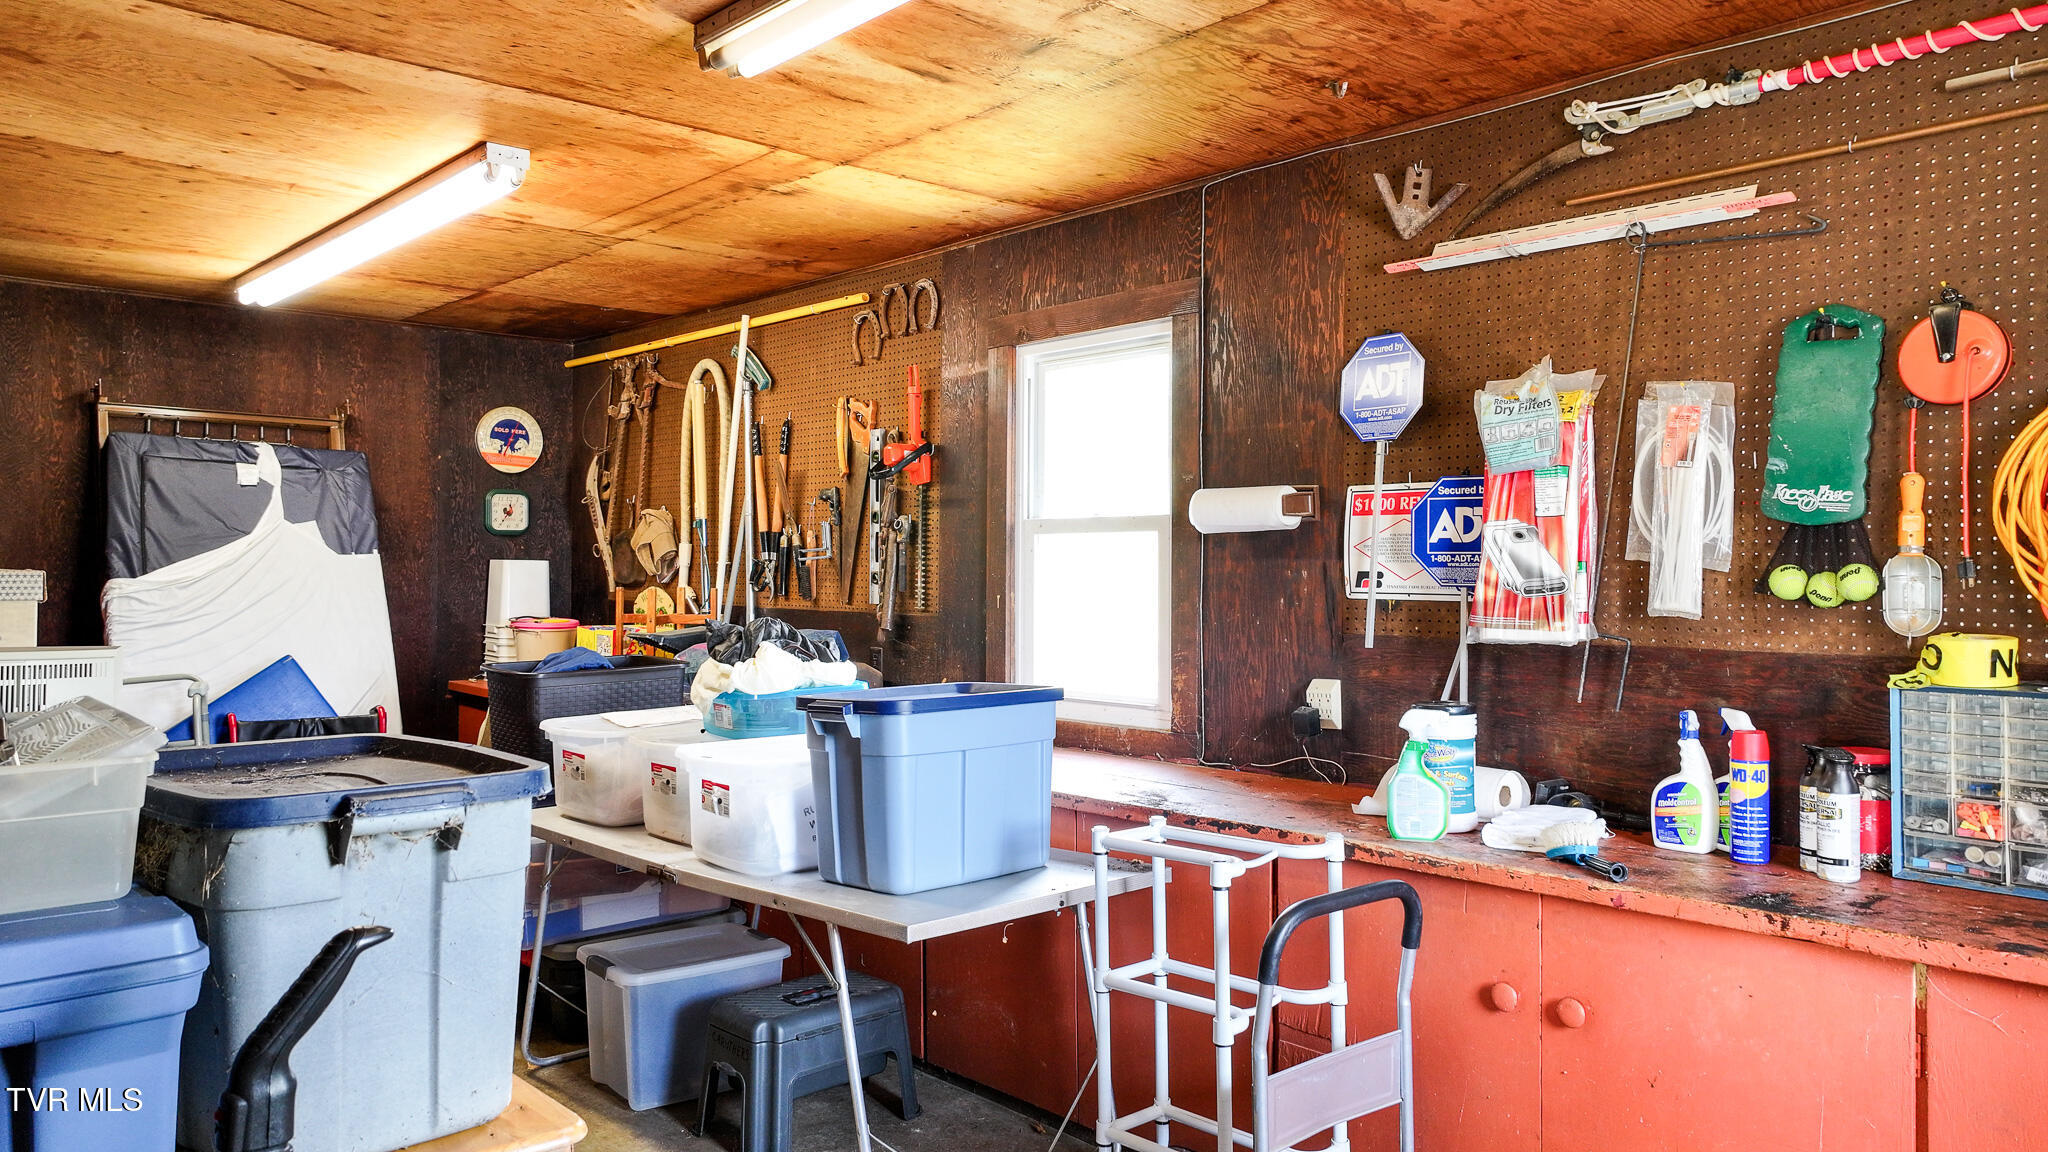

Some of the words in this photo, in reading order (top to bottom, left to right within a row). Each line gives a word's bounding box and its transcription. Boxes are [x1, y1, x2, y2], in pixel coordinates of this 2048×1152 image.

[1364, 344, 1393, 355] Secured
[1395, 342, 1404, 351] by
[1355, 362, 1411, 401] ADT
[1355, 407, 1407, 419] 1-800-ADT-ASAP
[1494, 405, 1515, 416] Dry
[1518, 398, 1552, 413] Filters
[1438, 486, 1477, 495] Secured
[1479, 485, 1484, 494] b
[1400, 496, 1422, 510] RE
[1430, 554, 1482, 563] 1-800-ADT-A
[1732, 767, 1766, 783] WD-40
